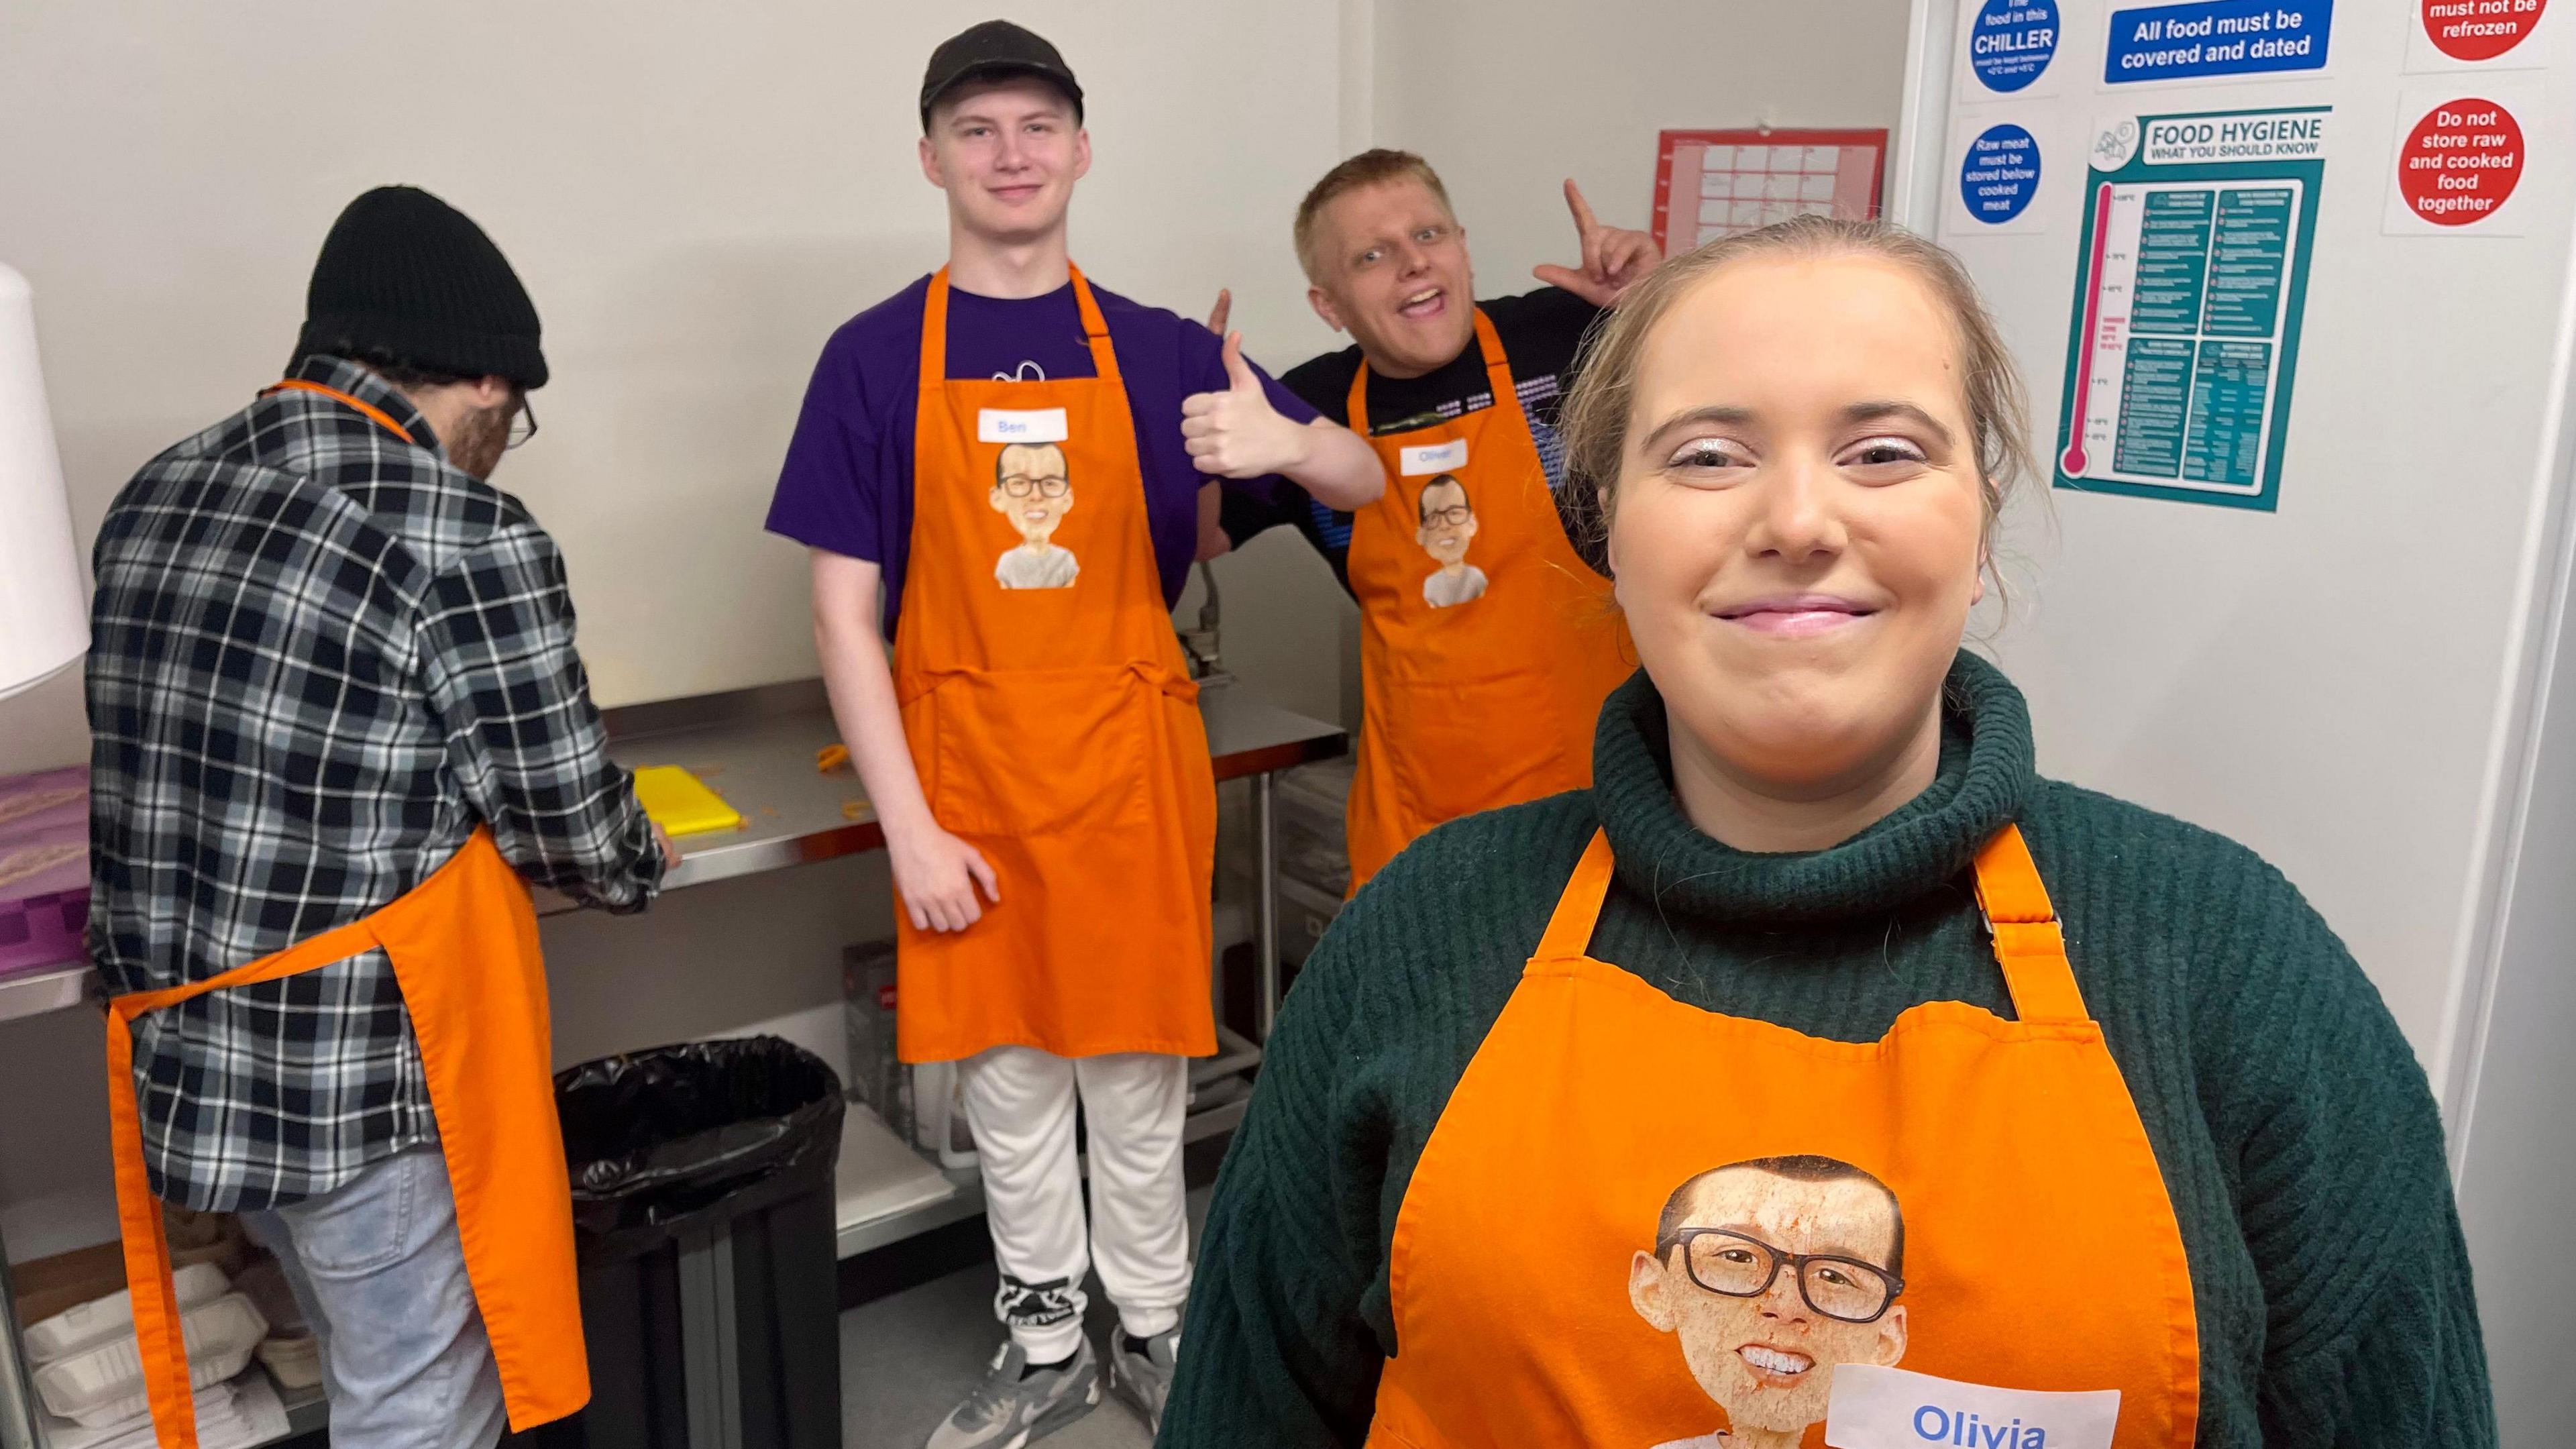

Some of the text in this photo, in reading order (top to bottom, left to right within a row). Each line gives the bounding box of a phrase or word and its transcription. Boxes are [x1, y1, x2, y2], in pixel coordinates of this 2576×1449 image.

[1986, 8, 2047, 25] food in this
[2430, 0, 2537, 17] must not be
[2133, 9, 2303, 42] All food must be
[2443, 21, 2517, 38] refrozen
[1975, 28, 2053, 54] CHILLER
[2121, 34, 2311, 69] covered and dated
[2436, 111, 2498, 127] Do not
[2152, 119, 2322, 145] FOOD HYGIENE
[2422, 133, 2506, 148] store raw
[1976, 137, 2029, 151] Raw meat
[2151, 142, 2318, 160] WHAT YOU SHOULD KNOW
[1980, 153, 2023, 166] must be
[2409, 152, 2514, 170] and cooked
[1966, 168, 2035, 182] stored below
[2437, 173, 2479, 190] food
[1978, 183, 2019, 197] cooked
[1983, 199, 2010, 211] meat
[2418, 195, 2493, 215] together
[998, 421, 1026, 433] Ben
[1914, 1405, 2045, 1449] Olivia
